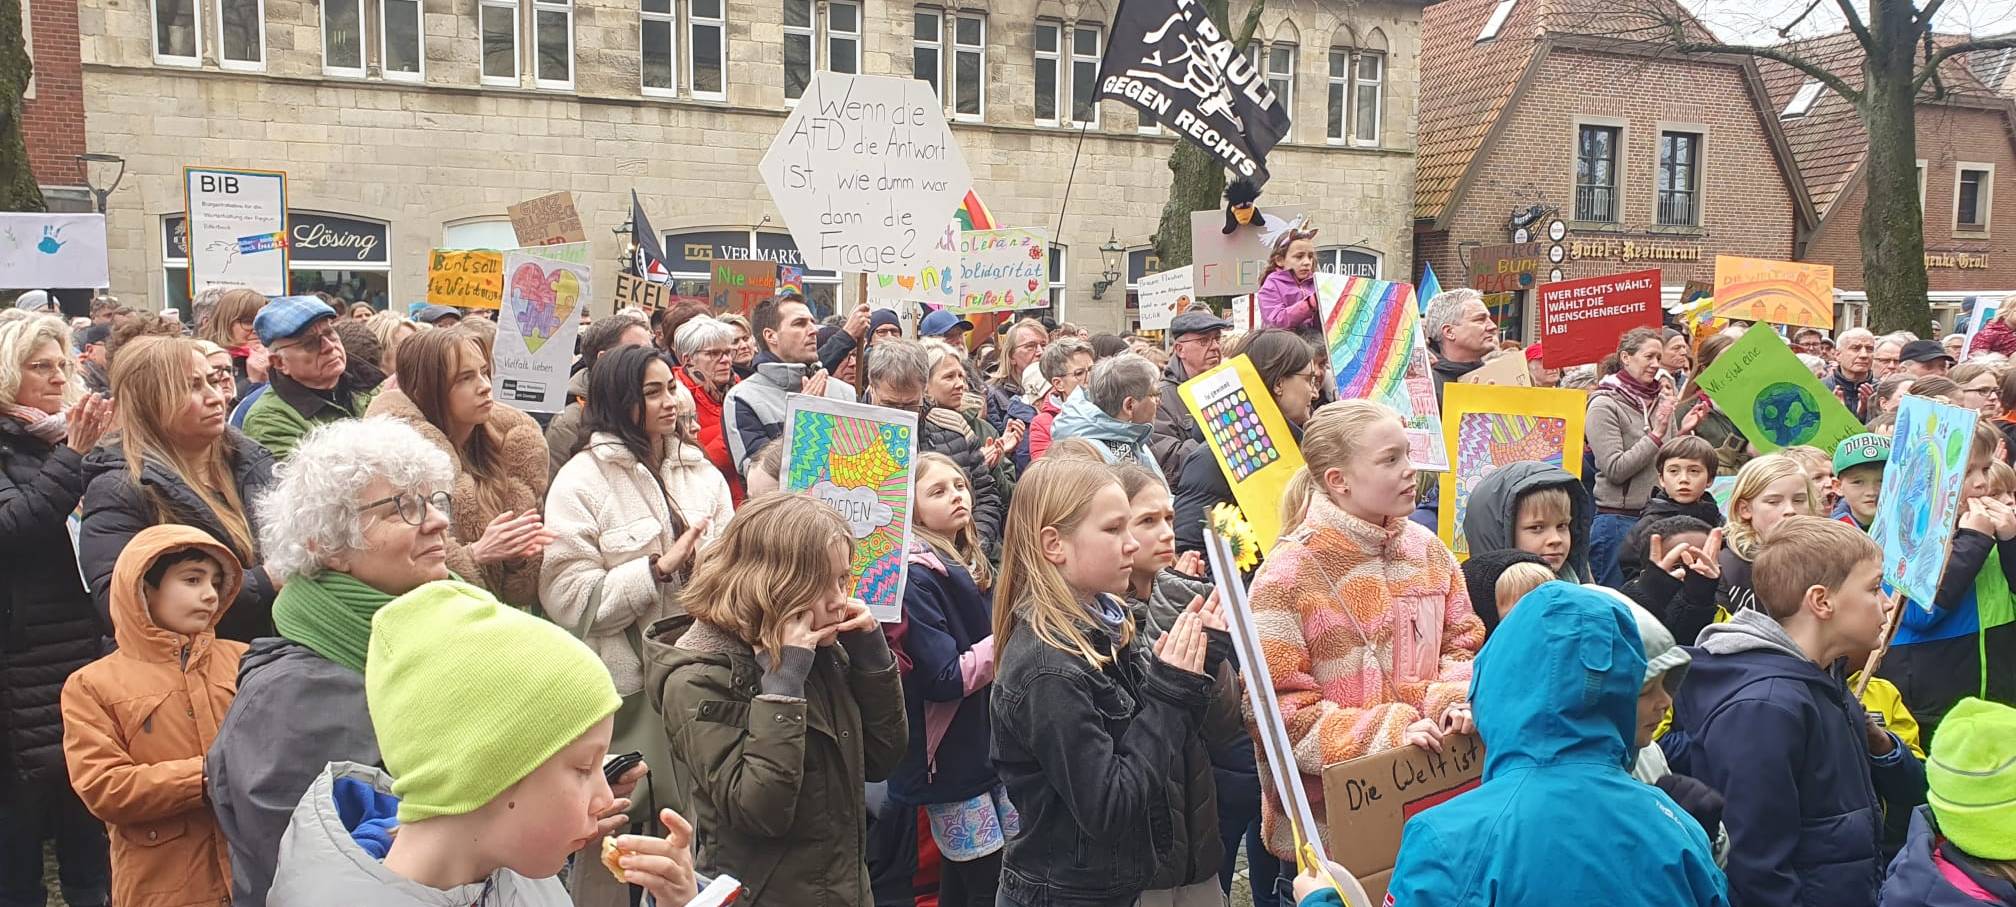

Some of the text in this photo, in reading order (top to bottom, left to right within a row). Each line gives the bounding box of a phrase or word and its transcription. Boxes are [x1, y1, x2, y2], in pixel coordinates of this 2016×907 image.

[1196, 17, 1276, 111] PAULI
[817, 76, 927, 126] Wenn die
[788, 115, 946, 160] AFD die Antwort
[1103, 76, 1257, 176] GEGEN RECHTS
[200, 175, 240, 194] BIB
[837, 169, 870, 191] wie
[876, 162, 914, 191] dumm
[921, 180, 950, 191] war
[820, 194, 913, 227] dann die
[293, 223, 378, 260] Lösing
[819, 228, 916, 272] Frage?
[961, 235, 1031, 253] oleranz
[1571, 240, 1701, 262] Hotel Restaurant
[717, 264, 746, 288] Nie
[1548, 278, 1653, 301] WER RECHTS WÄHLT,
[616, 274, 667, 310] EKEL
[1549, 297, 1604, 312] WÄHLT DIE
[1549, 302, 1646, 323] MENSCHENRECHTE
[1550, 324, 1568, 335] AB!
[1845, 436, 1891, 456] DUBLIN
[1346, 737, 1477, 811] Die Welt ist
